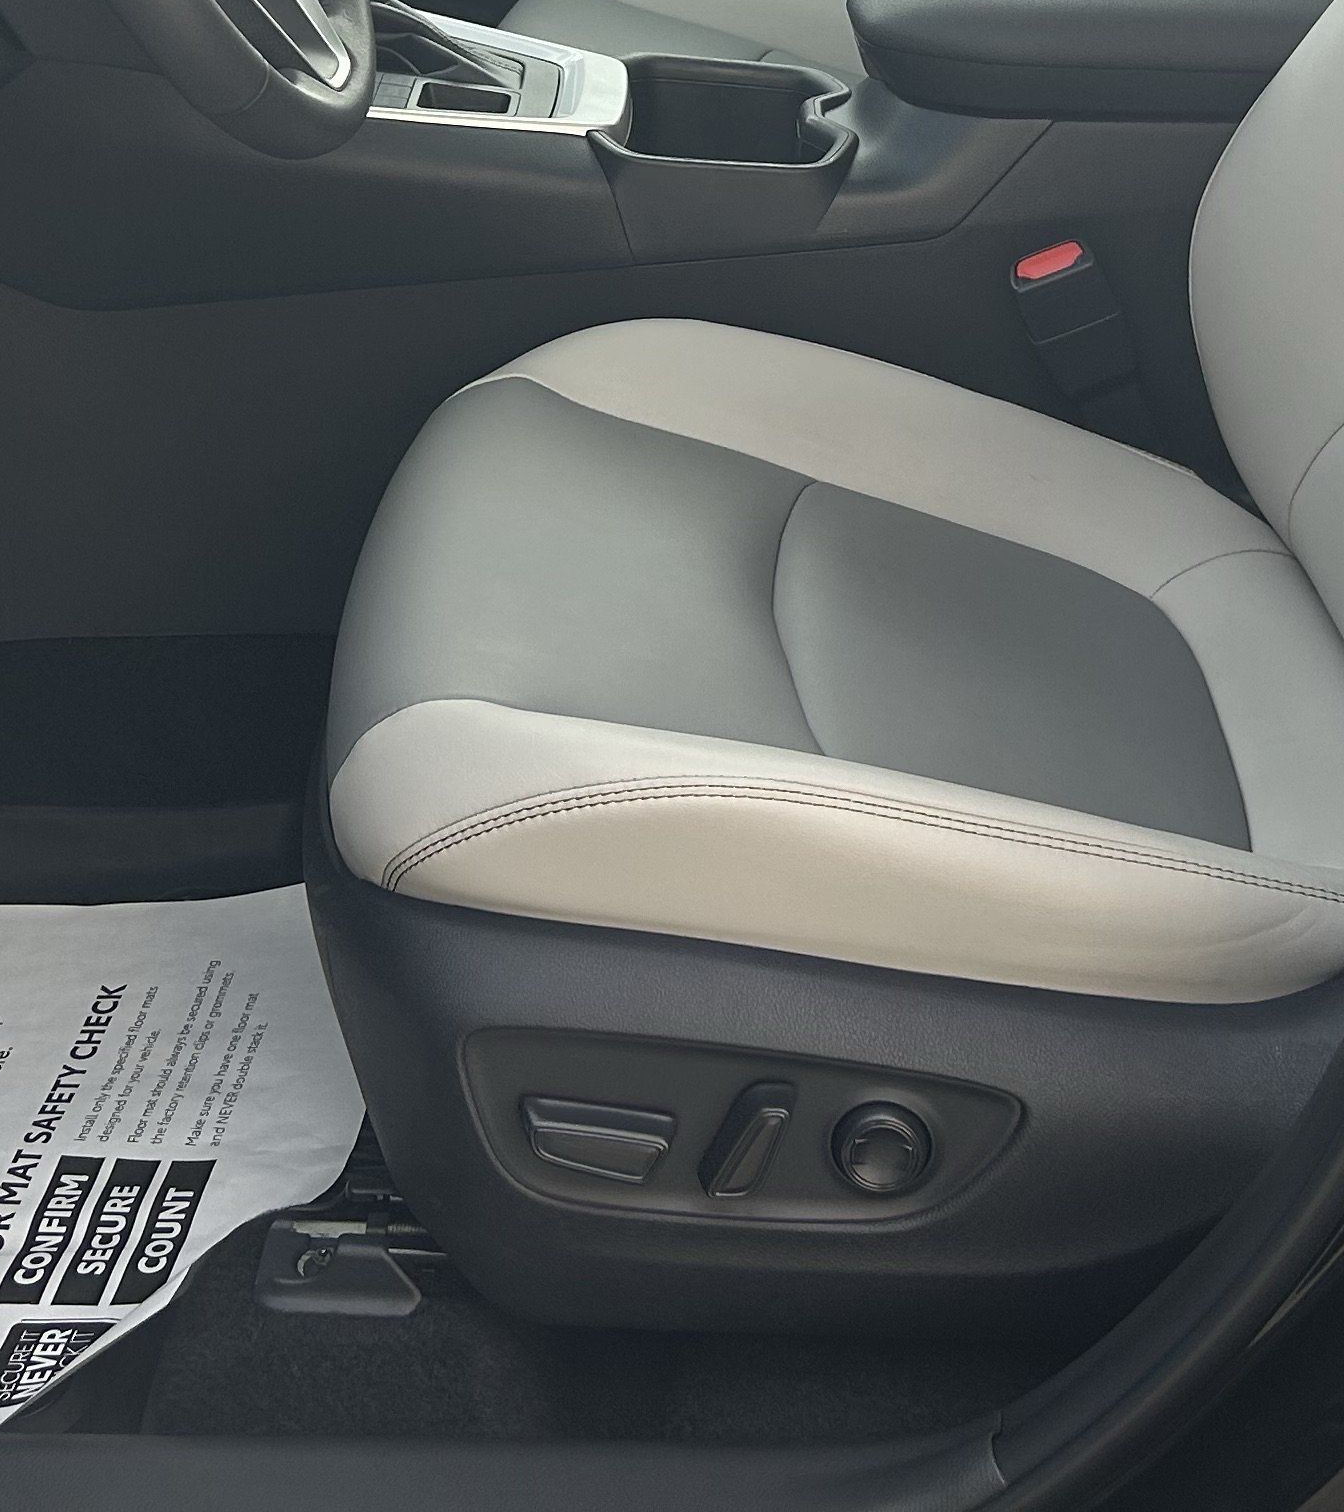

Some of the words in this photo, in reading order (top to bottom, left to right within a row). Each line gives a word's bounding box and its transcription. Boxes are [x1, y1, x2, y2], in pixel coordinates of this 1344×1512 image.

[142, 986, 159, 1009] mats
[245, 992, 259, 1010] mat
[128, 1011, 148, 1033] floor
[232, 1012, 250, 1034] floor
[112, 1034, 137, 1075] specified
[127, 1114, 148, 1143] Floor
[143, 1099, 158, 1117] mat
[151, 1069, 172, 1098] should
[166, 1033, 187, 1067] always
[187, 986, 209, 1022] secured
[202, 960, 221, 984] using
[227, 1035, 241, 1052] one
[23, 1064, 87, 1144] SAFETY
[69, 984, 128, 1060] CHECK
[214, 1053, 233, 1077] have
[101, 1076, 117, 1092] the
[150, 1122, 167, 1145] the
[161, 1090, 185, 1123] factory
[176, 1052, 200, 1091] retention
[205, 1020, 214, 1030] or
[210, 1077, 224, 1095] you
[210, 1126, 225, 1147] and
[218, 1091, 238, 1125] NEVER
[231, 1055, 253, 1089] double
[247, 1030, 263, 1053] stack
[92, 1091, 111, 1112] only
[98, 1099, 127, 1143] designed
[118, 1083, 133, 1098] for
[130, 1063, 144, 1084] your
[200, 1096, 215, 1117] sure
[73, 1114, 99, 1141] Install
[185, 1114, 206, 1147] Make
[13, 1174, 90, 1285] CONFIRM
[76, 1184, 140, 1275] SECURE
[137, 1187, 194, 1274] COUNT
[20, 1329, 41, 1342] IT
[11, 1328, 73, 1400] NEVER
